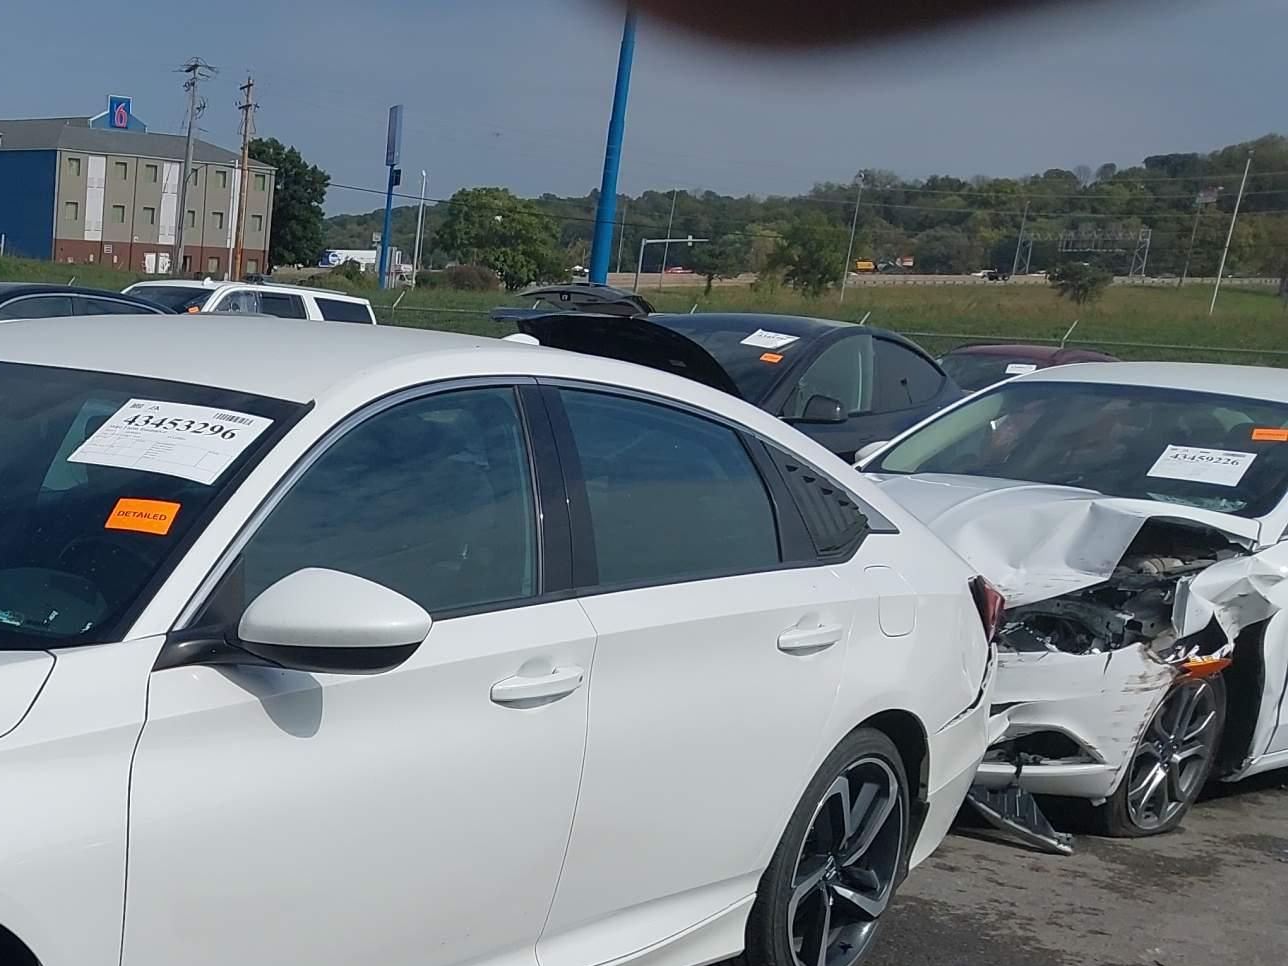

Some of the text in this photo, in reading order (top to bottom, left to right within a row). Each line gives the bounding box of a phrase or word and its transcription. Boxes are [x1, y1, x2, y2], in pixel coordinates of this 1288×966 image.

[114, 102, 128, 128] 6
[123, 414, 241, 440] 43453296
[1169, 453, 1240, 466] 43459226
[116, 510, 168, 521] DETAILED
